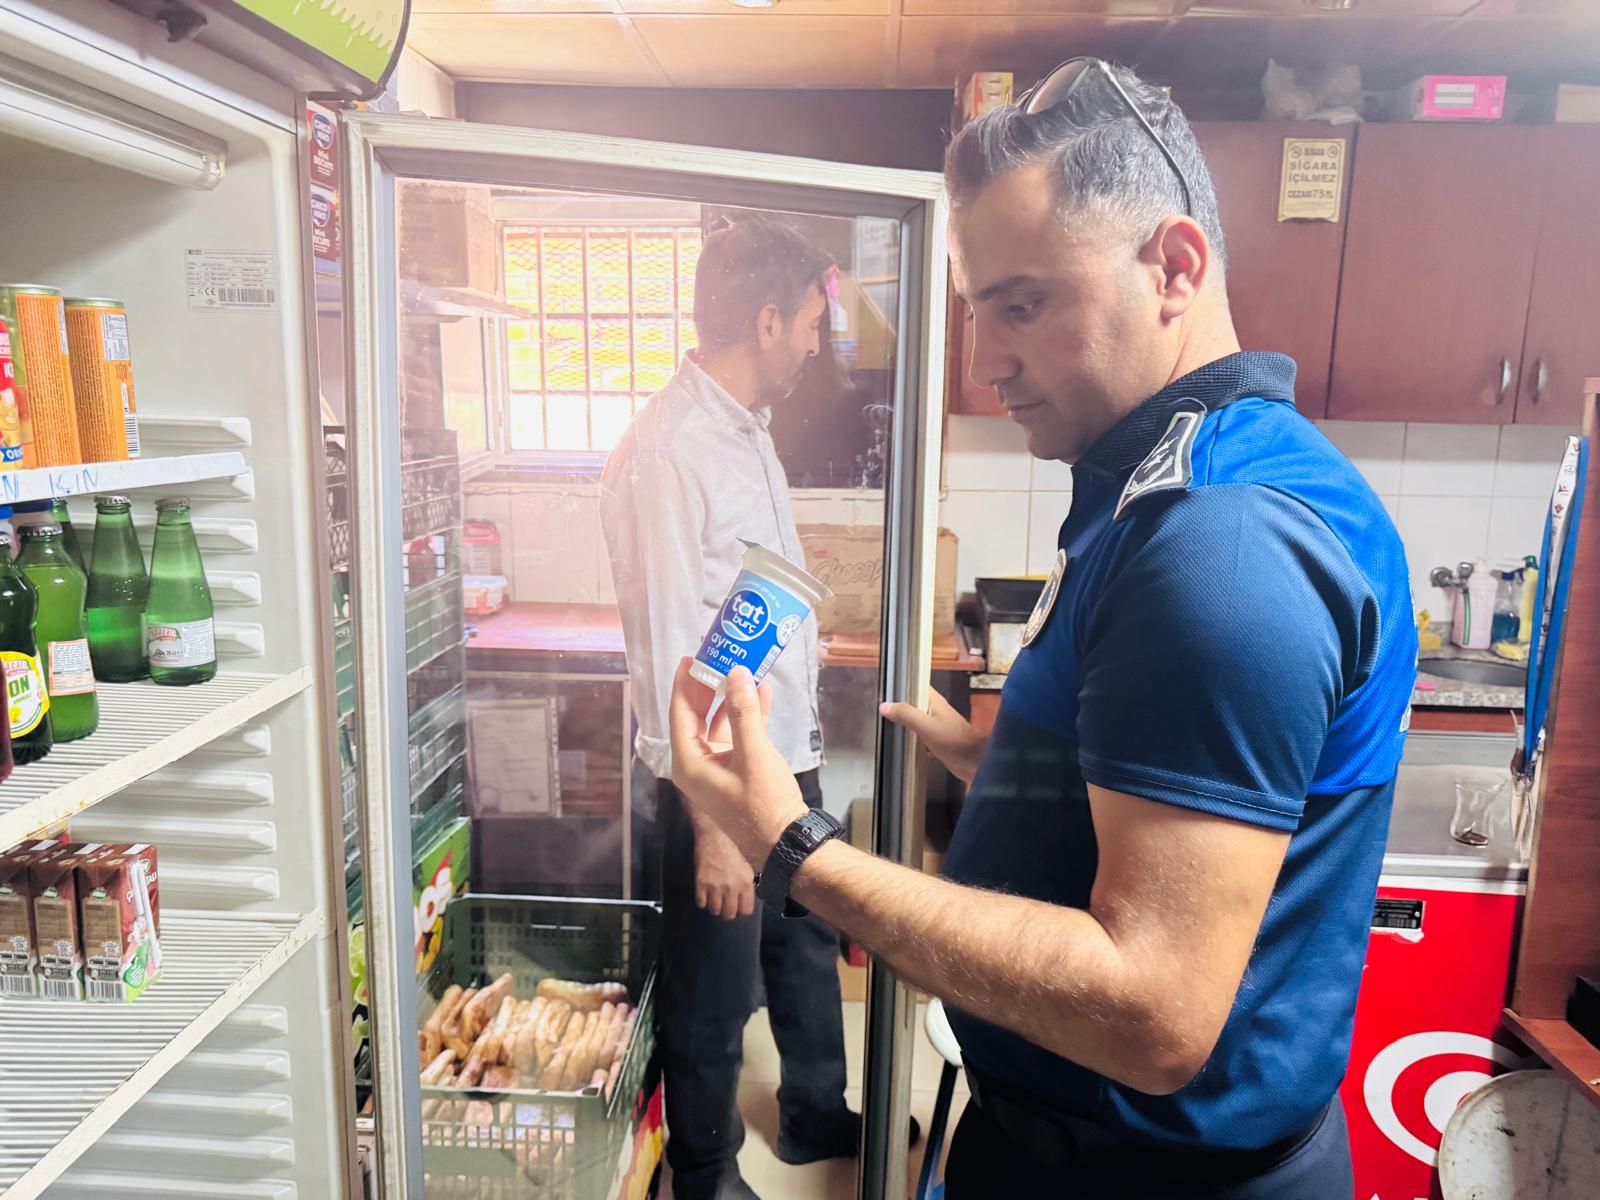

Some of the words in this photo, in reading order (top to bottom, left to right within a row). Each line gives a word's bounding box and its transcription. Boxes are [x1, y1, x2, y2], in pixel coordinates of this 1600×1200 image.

[1289, 159, 1337, 170] SİGARA
[1288, 172, 1336, 184] İÇİLMEZ
[731, 594, 766, 624] tat
[732, 613, 757, 634] burç
[706, 646, 718, 659] 190
[719, 654, 732, 667] ml
[711, 632, 748, 660] ayran
